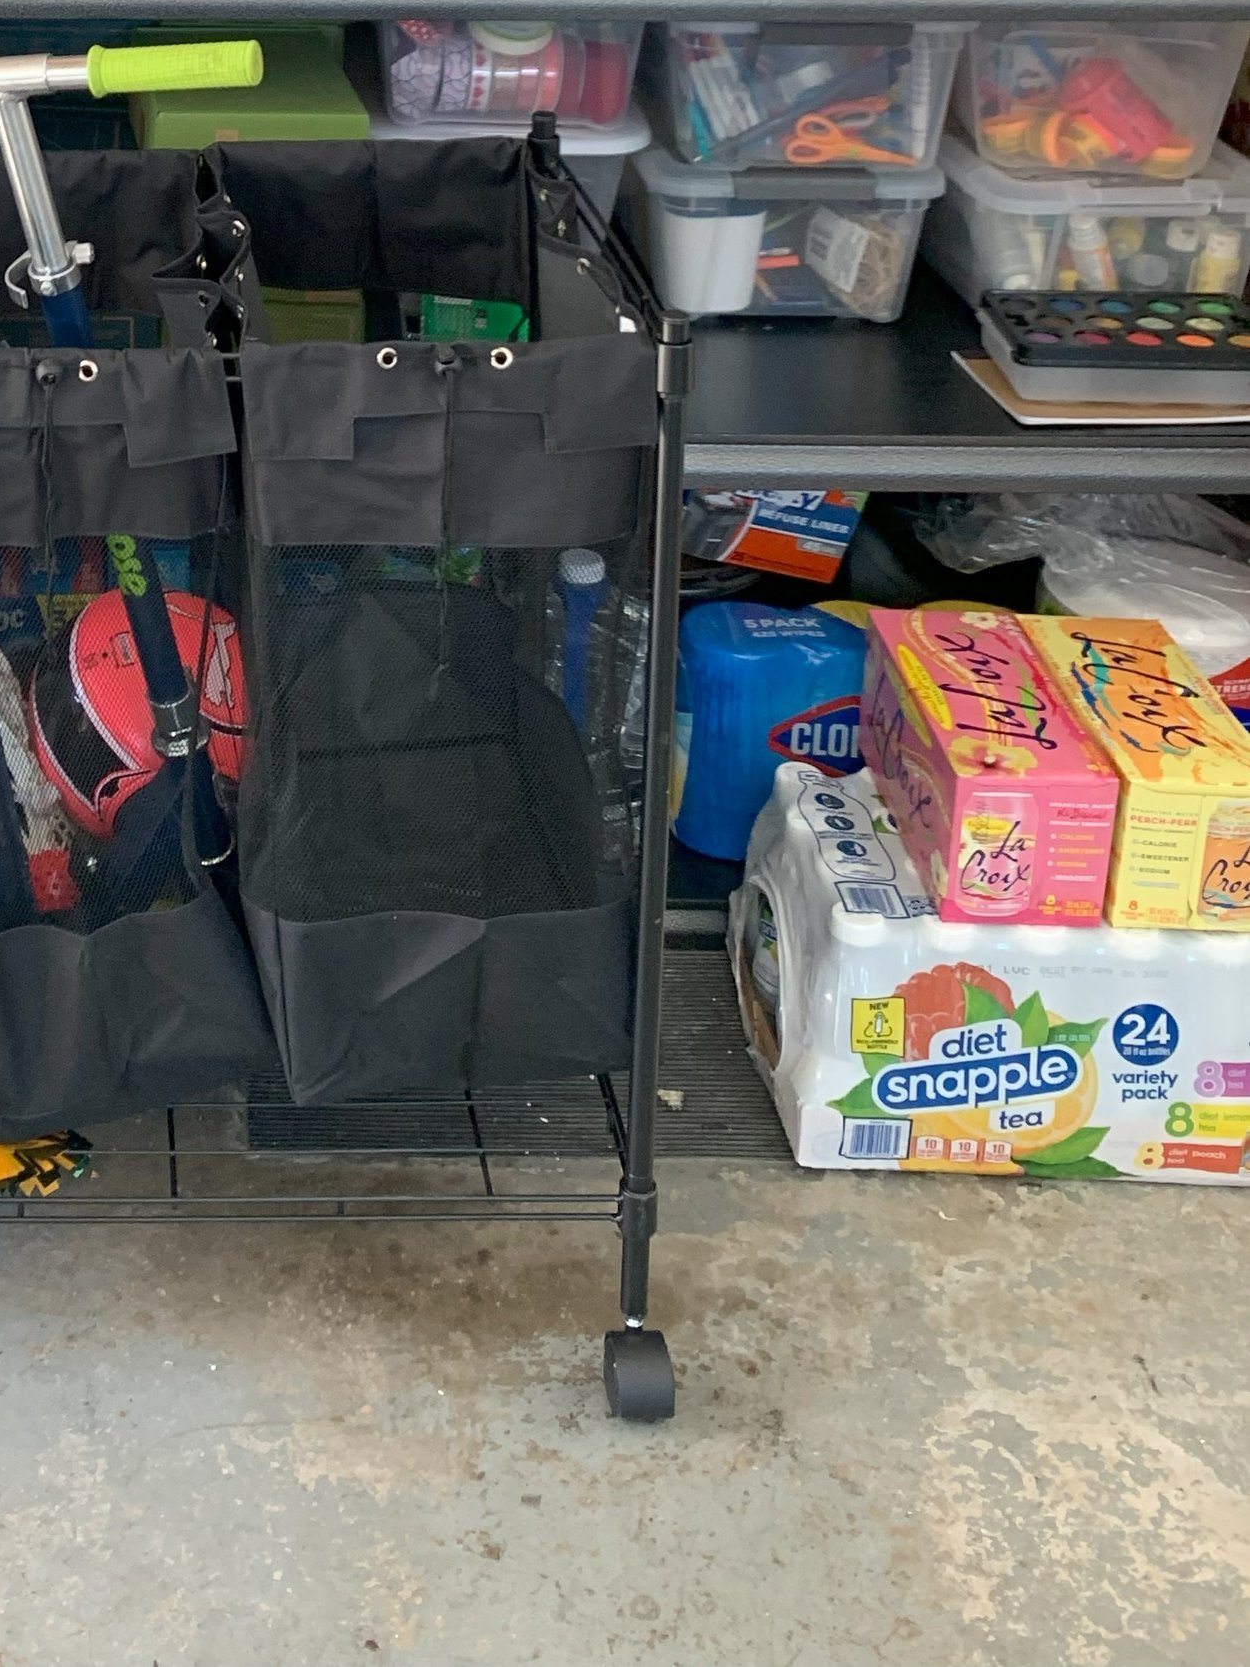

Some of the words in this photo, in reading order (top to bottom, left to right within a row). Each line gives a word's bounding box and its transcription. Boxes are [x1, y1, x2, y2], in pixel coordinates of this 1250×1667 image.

[758, 507, 807, 525] REFUSE
[744, 618, 757, 629] 5
[761, 617, 821, 629] PACK
[790, 722, 861, 759] CLO
[990, 821, 1027, 863] La
[960, 849, 1030, 892] Croix
[1045, 894, 1056, 905] 8
[1129, 900, 1138, 911] 8
[869, 1001, 890, 1011] NEW
[1120, 1013, 1171, 1047] 24
[941, 1024, 1008, 1059] diet
[1148, 1047, 1171, 1056] bottles
[886, 1047, 1069, 1109] snapple
[1112, 1070, 1179, 1088] variety
[1193, 1060, 1226, 1098] 8
[1228, 1067, 1247, 1078] diet
[1228, 1081, 1244, 1090] tea
[1121, 1086, 1168, 1103] pack
[999, 1110, 1044, 1130] tea
[1164, 1101, 1195, 1138] 8
[1199, 1111, 1219, 1121] diet
[1199, 1124, 1216, 1133] tea
[924, 1139, 938, 1150] 10
[959, 1141, 972, 1152] 10
[992, 1144, 1006, 1154] 10
[1134, 1140, 1166, 1172] 8
[1168, 1148, 1188, 1157] diet
[1192, 1150, 1227, 1160] peach
[1166, 1156, 1185, 1165] tea
